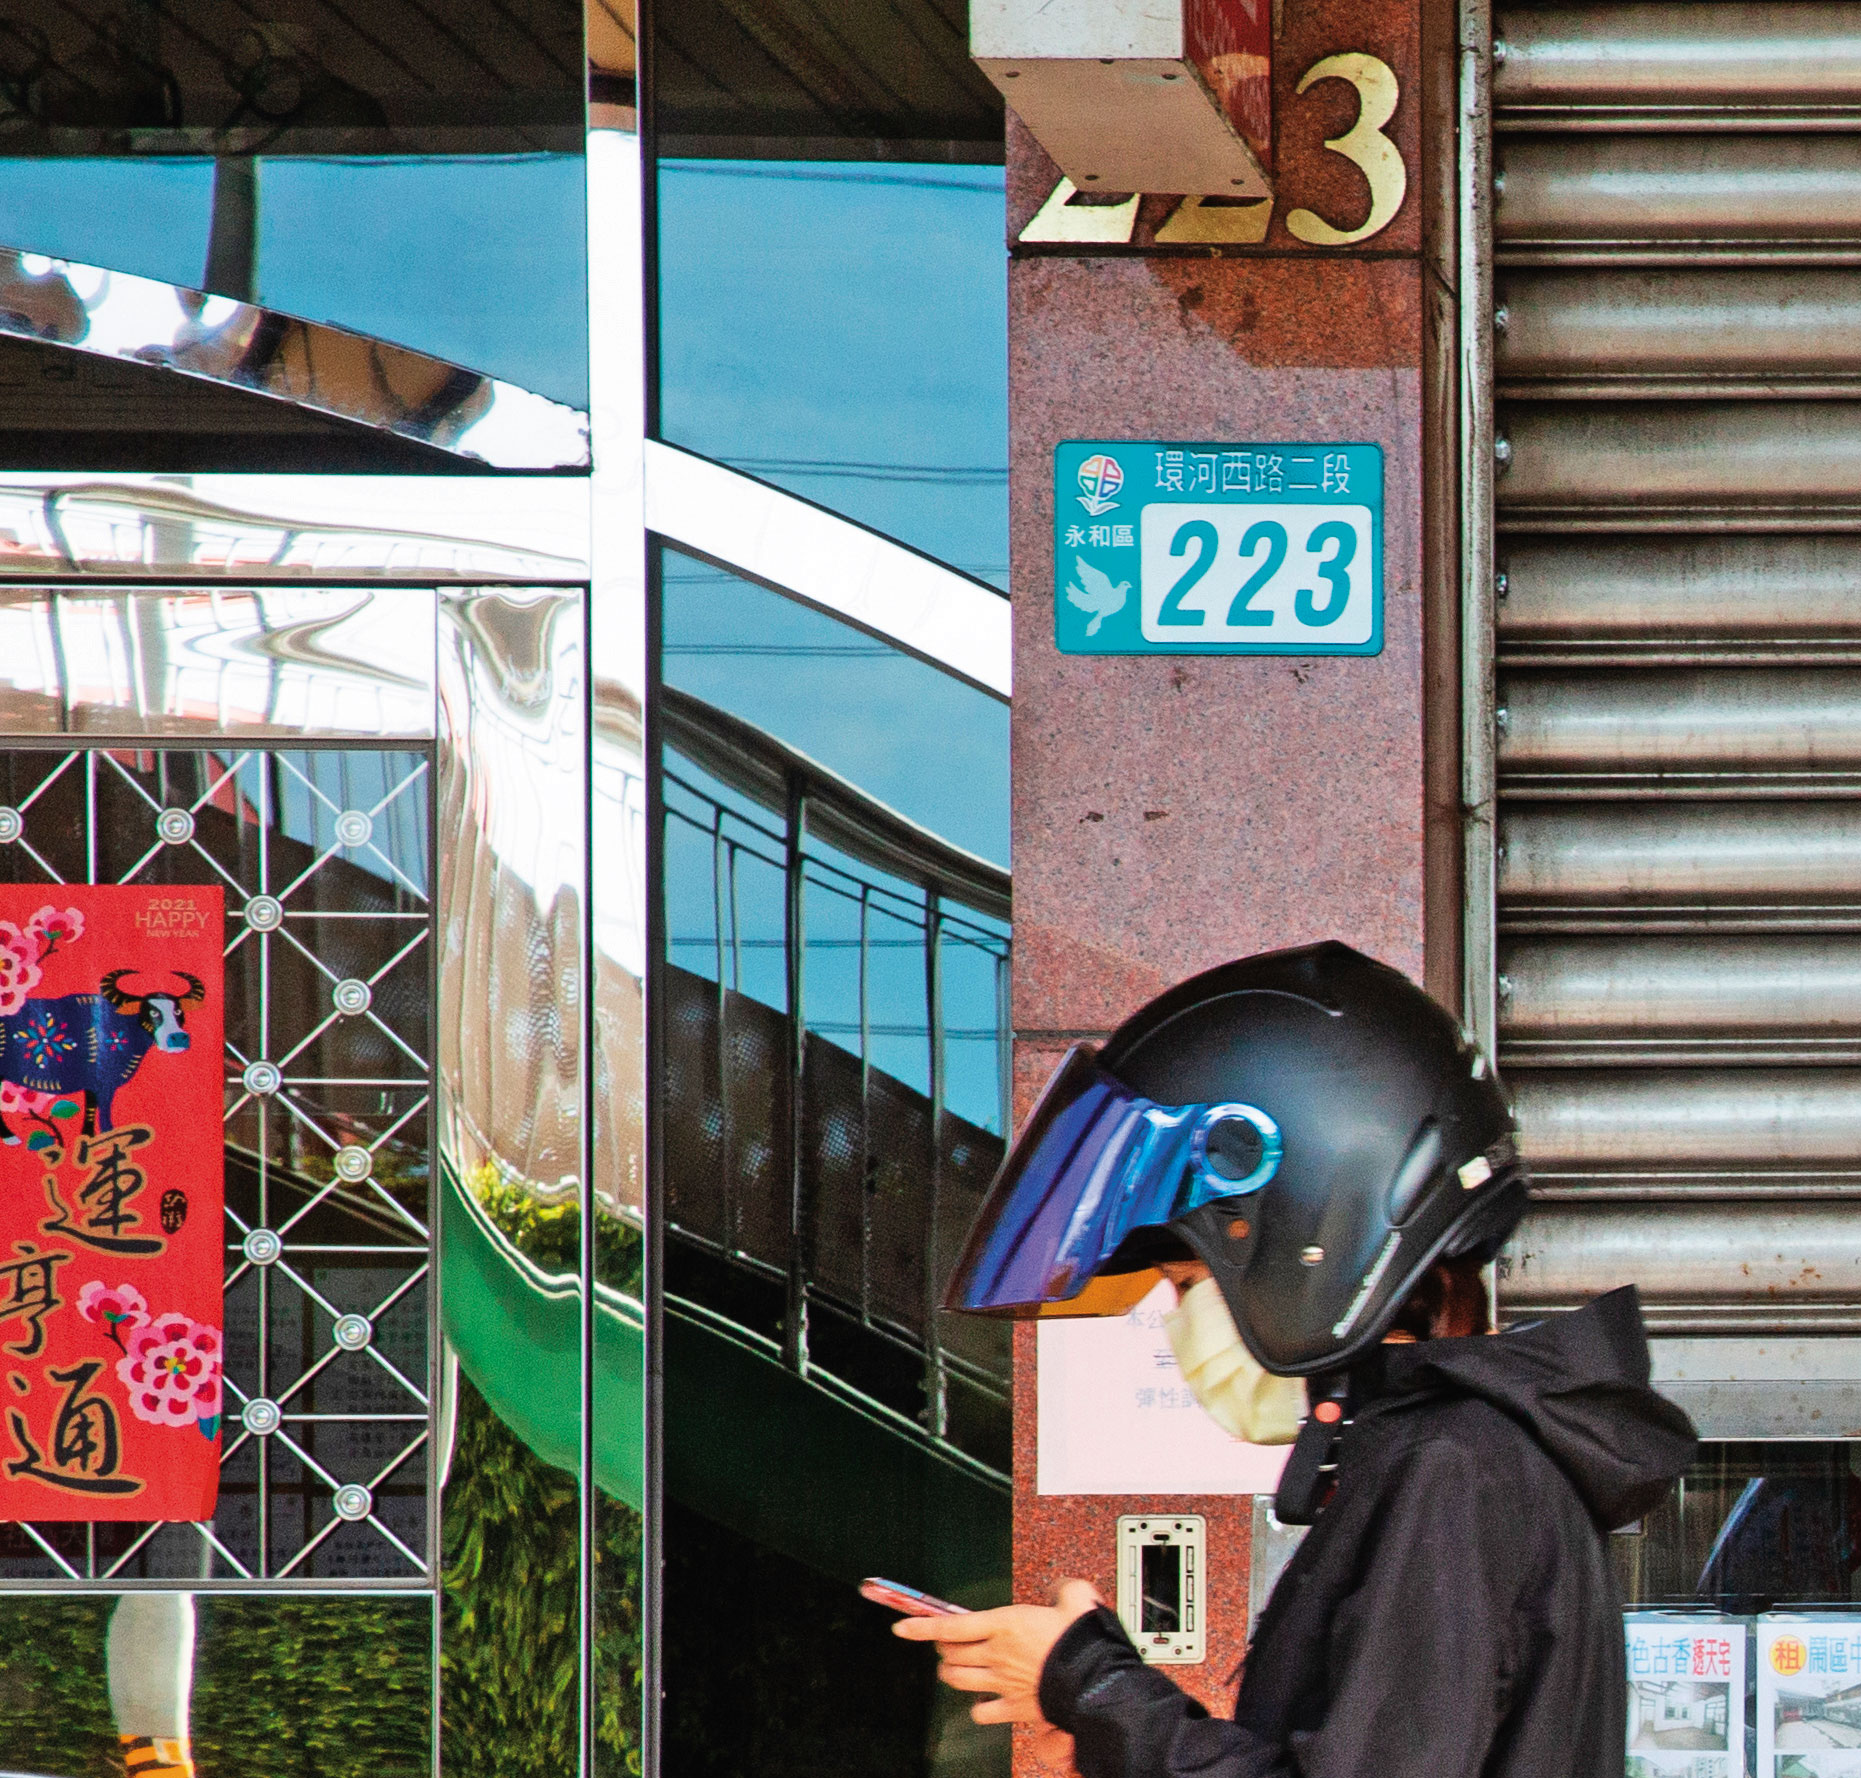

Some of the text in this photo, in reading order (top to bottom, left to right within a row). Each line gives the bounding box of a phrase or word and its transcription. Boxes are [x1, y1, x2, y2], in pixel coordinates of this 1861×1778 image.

[1154, 450, 1353, 497] 環河西路二段
[1064, 524, 1135, 549] 永和區
[1156, 519, 1358, 628] 223
[135, 911, 211, 929] HAPPY
[147, 898, 197, 911] 2021
[1626, 1637, 1731, 1676] 色古香透天宅
[1775, 1641, 1803, 1672] 租
